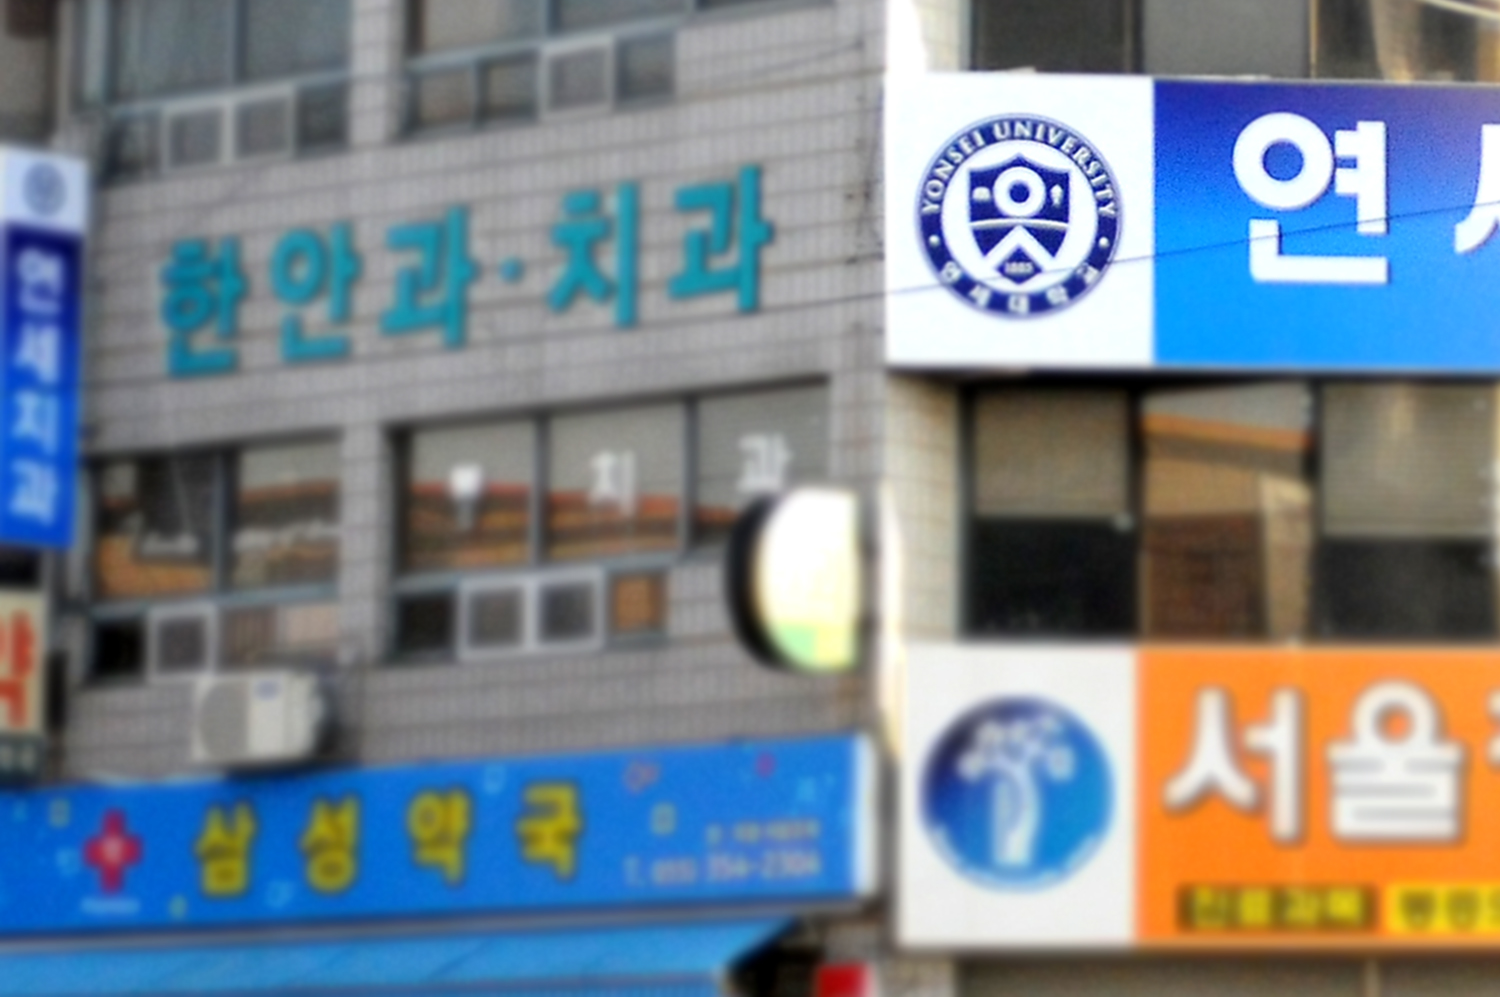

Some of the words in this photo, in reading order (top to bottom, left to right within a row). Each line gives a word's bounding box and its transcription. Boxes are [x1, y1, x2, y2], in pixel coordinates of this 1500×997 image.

[920, 130, 986, 216] YONSEI
[993, 119, 1117, 218] UNIVERSITY
[9, 247, 66, 526] 연세치과
[194, 782, 584, 896] 삼성약국
